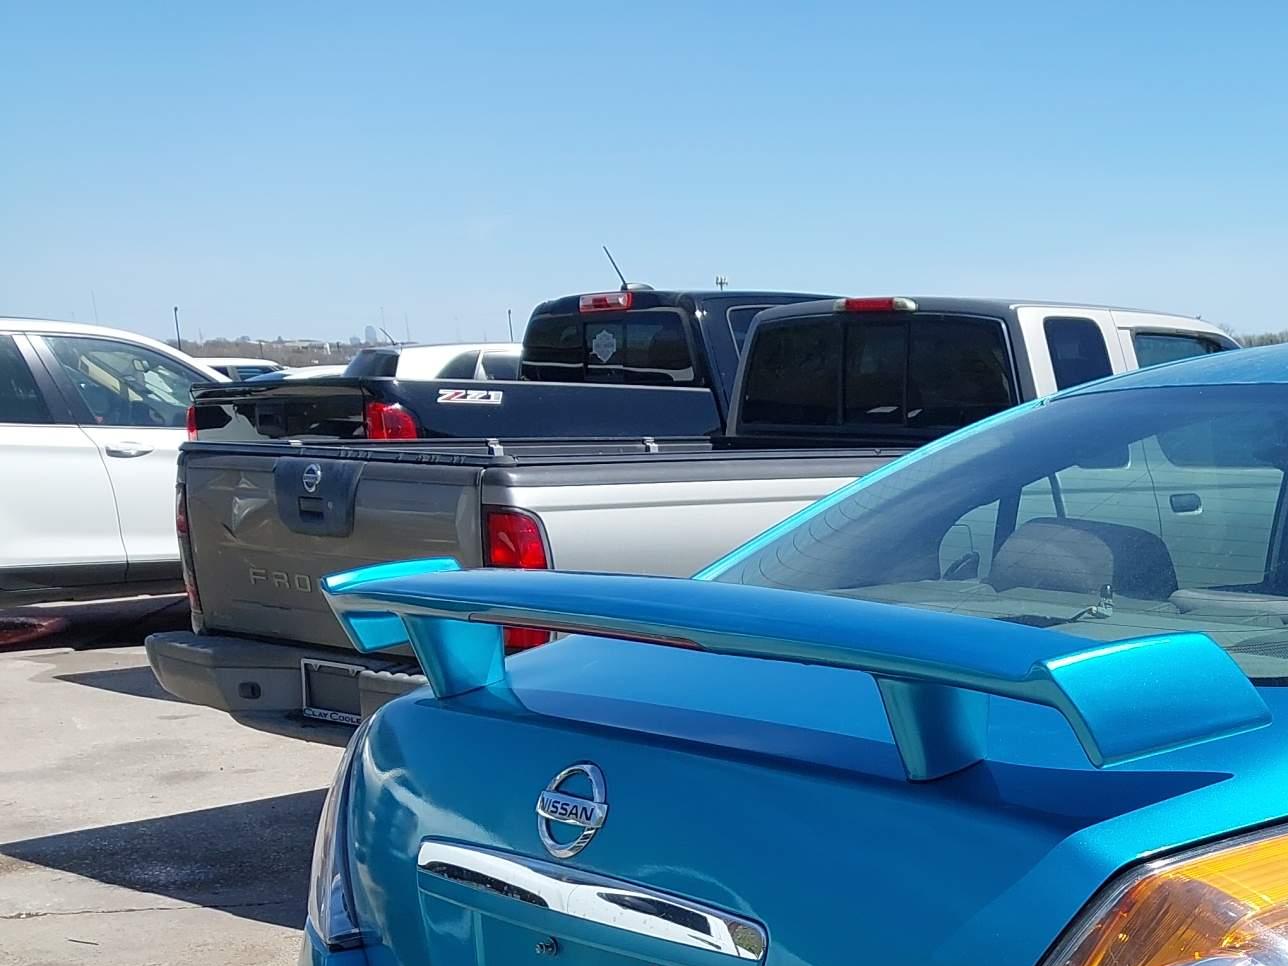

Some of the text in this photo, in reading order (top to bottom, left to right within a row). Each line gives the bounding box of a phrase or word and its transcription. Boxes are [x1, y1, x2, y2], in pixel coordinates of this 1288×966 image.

[437, 389, 503, 404] Z71
[249, 567, 319, 592] FRO
[304, 708, 328, 719] CLAY
[542, 796, 595, 821] NISSAN
